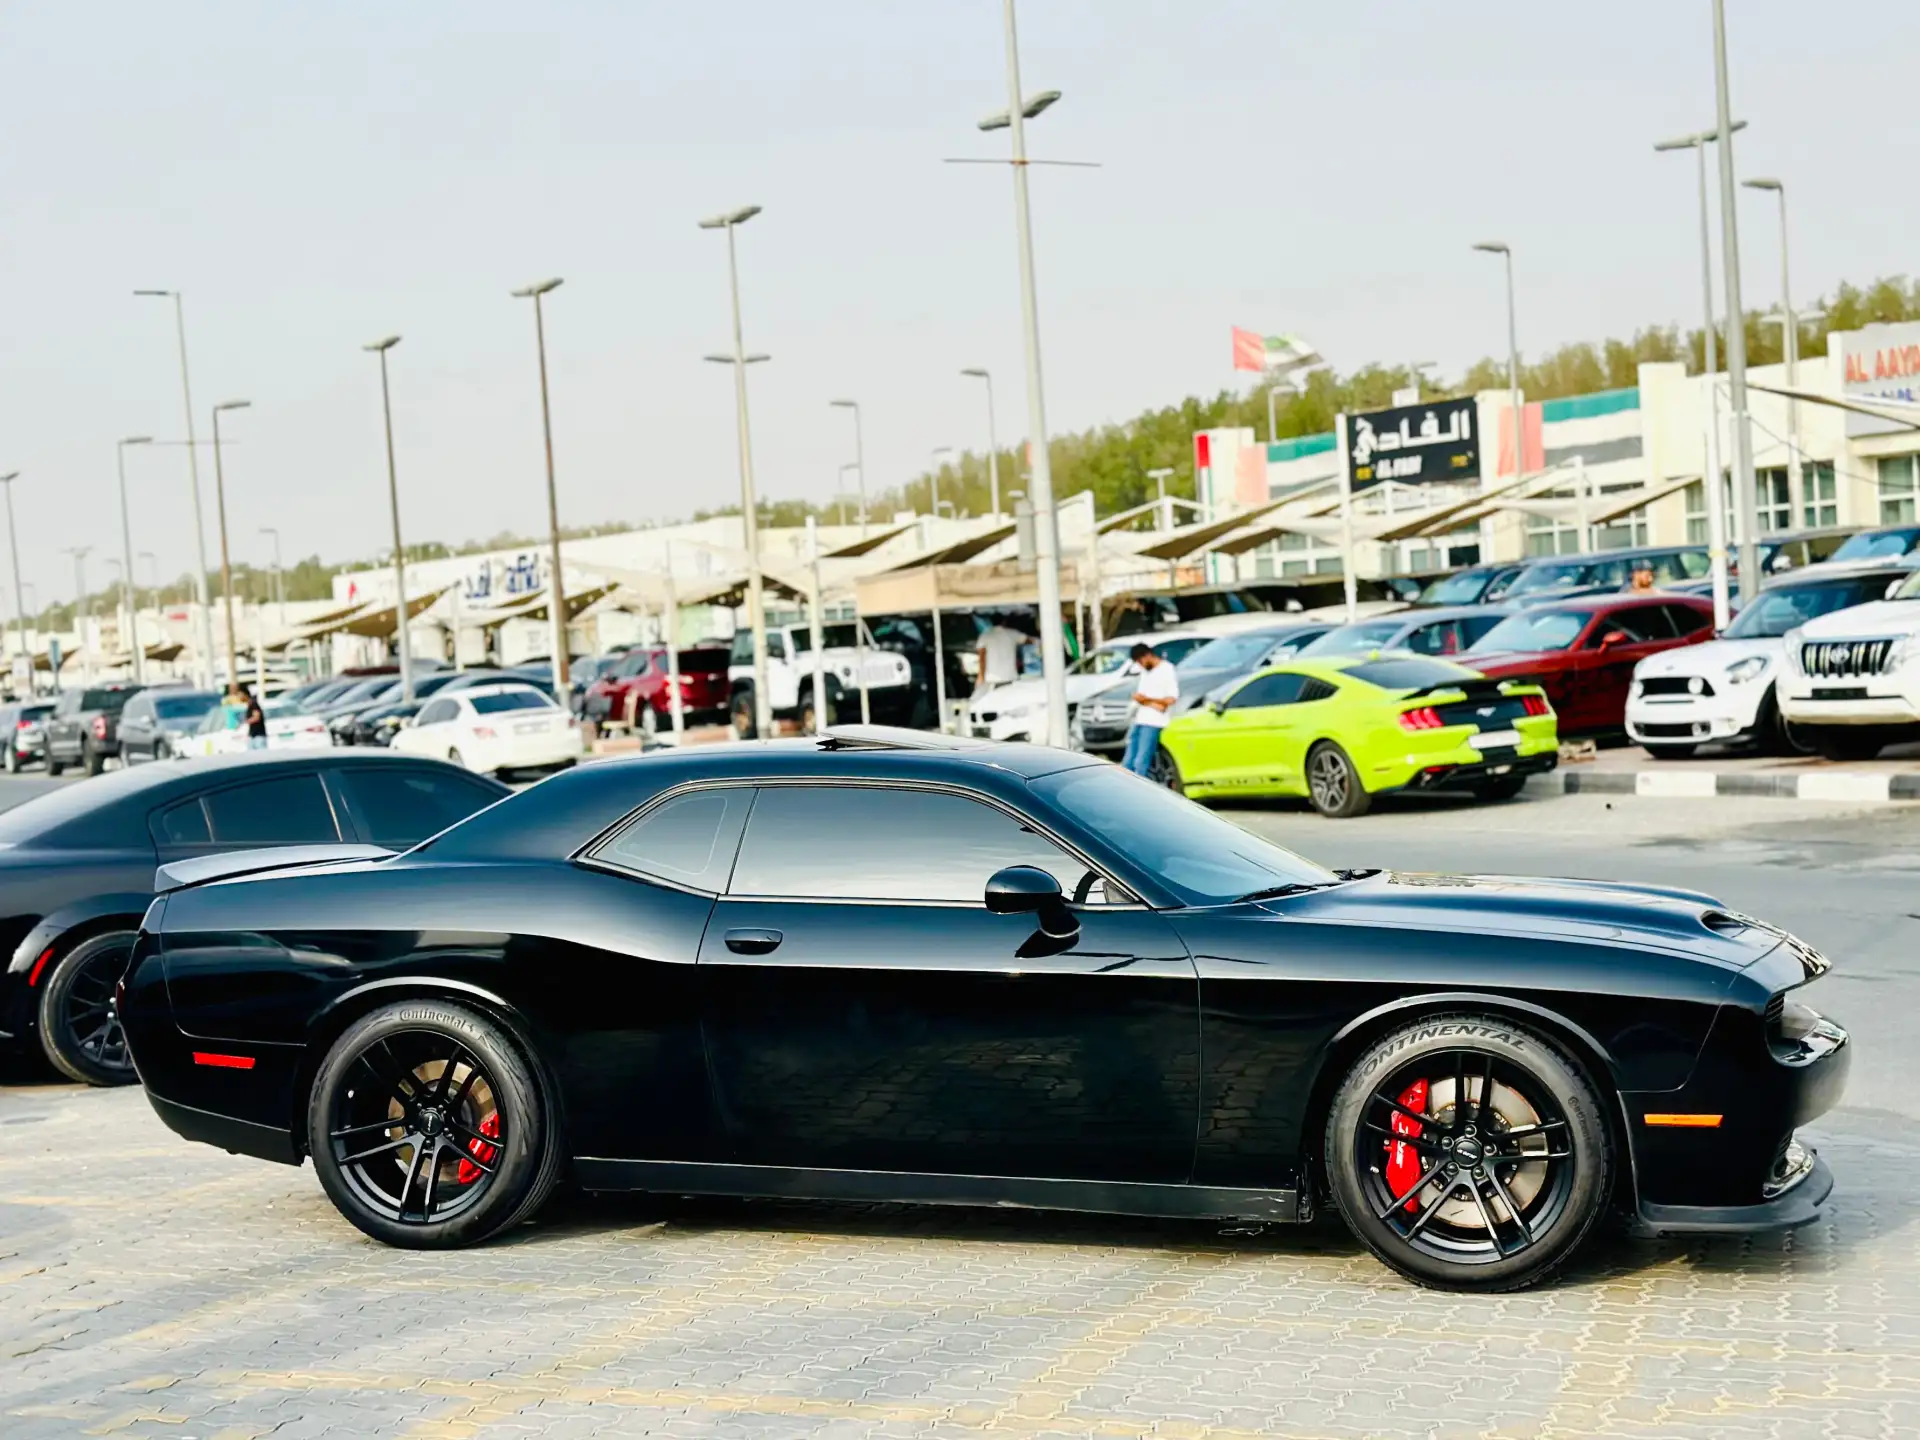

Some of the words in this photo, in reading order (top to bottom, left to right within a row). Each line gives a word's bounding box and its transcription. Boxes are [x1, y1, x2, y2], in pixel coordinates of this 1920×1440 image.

[1844, 352, 1869, 383] AL
[400, 1008, 467, 1030] Continental
[1352, 1024, 1526, 1090] CONTINENTAL
